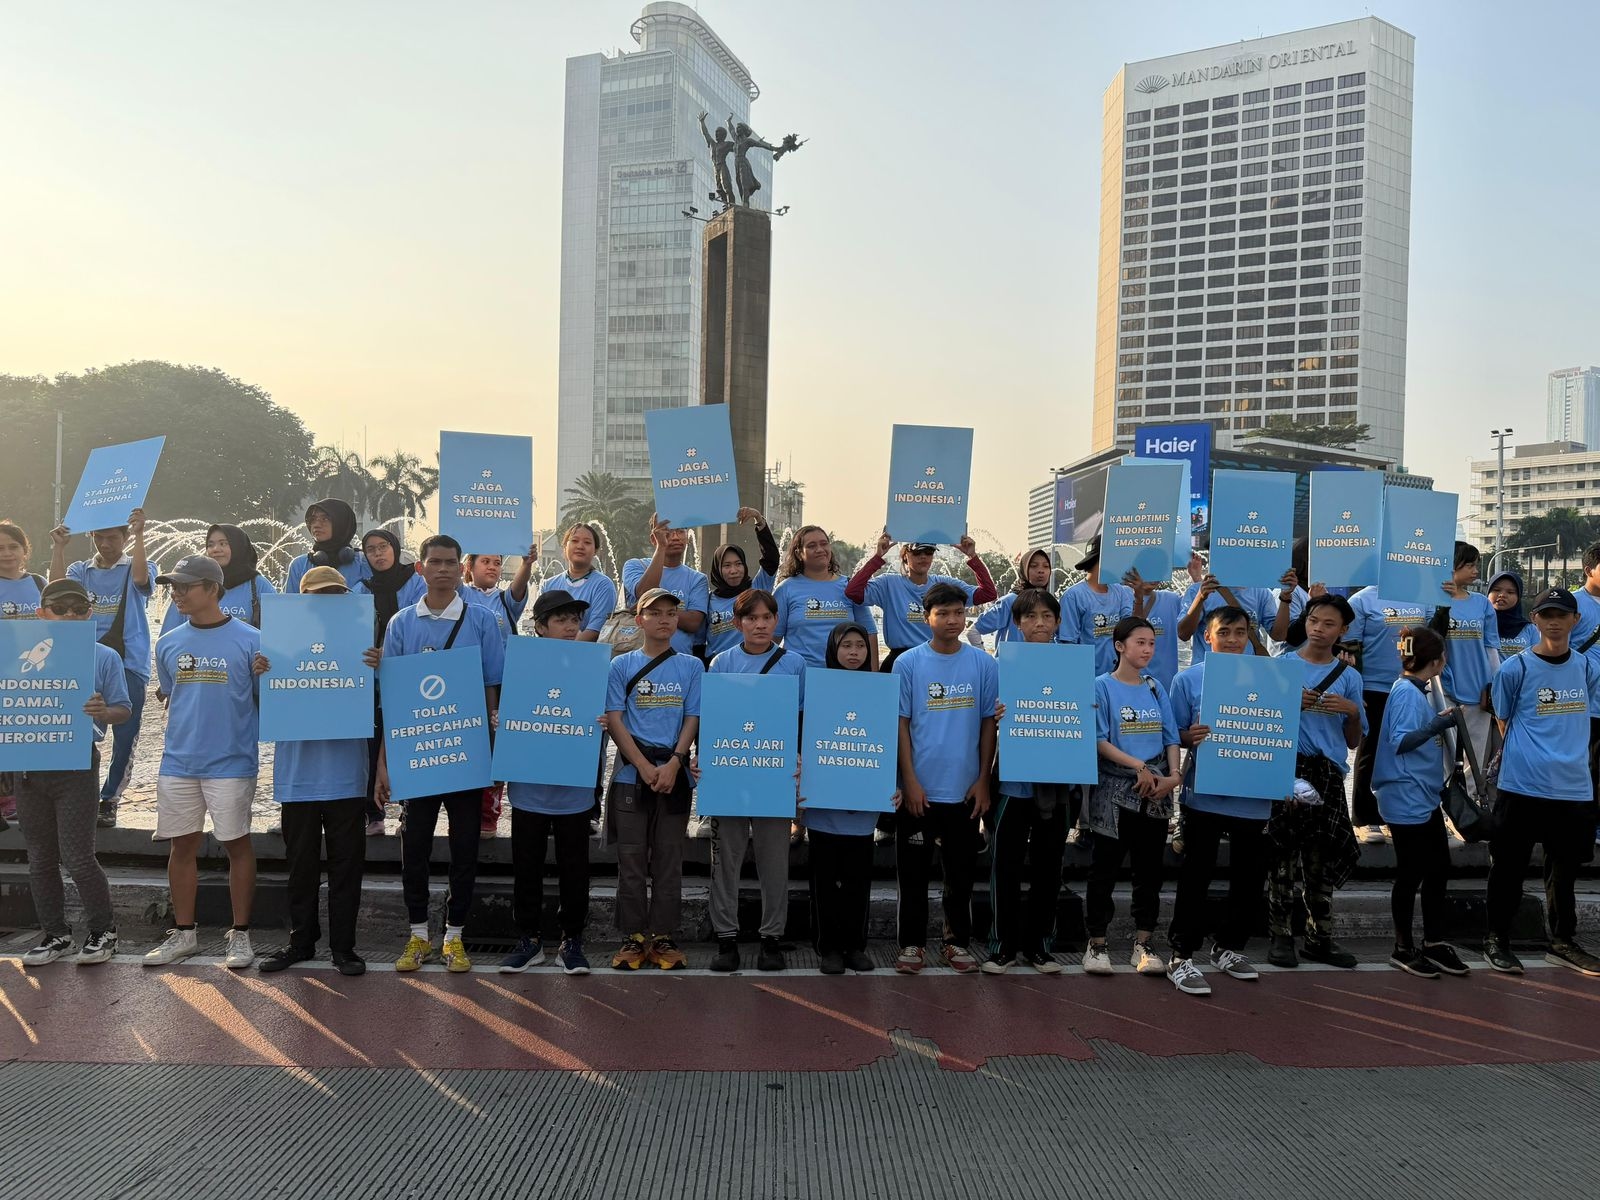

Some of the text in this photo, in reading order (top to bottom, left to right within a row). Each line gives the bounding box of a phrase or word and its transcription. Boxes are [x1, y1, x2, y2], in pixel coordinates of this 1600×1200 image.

[1172, 40, 1357, 87] MANDARIN ORIENTAL
[1145, 437, 1197, 453] Haier
[678, 461, 709, 472] JAGA
[101, 475, 129, 486] JAGA
[660, 474, 723, 489] INDONESIA
[914, 480, 944, 490] JAGA
[84, 482, 139, 498] STABILITAS
[470, 482, 503, 492] JAGA
[82, 493, 133, 507] NASIONAL
[453, 494, 520, 506] STABILITAS
[895, 493, 954, 504] INDONESIA
[456, 508, 517, 519] NASIONAL
[1109, 514, 1170, 523] KAMI OPTIMIS
[1115, 526, 1163, 535] INDONESIA
[1236, 525, 1268, 535] JAGA
[1332, 525, 1360, 534] JAGA
[1114, 537, 1162, 547] EMAS 2045
[1217, 538, 1279, 549] INDONESIA
[1315, 538, 1370, 548] INDONESIA
[1404, 541, 1432, 552] JAGA
[1386, 552, 1441, 566] INDONESIA
[296, 661, 340, 672] JAGA
[0, 679, 79, 690] NDONESIA
[269, 678, 355, 689] INDONESIA
[3, 696, 64, 709] DAMAI,
[1016, 699, 1078, 710] INDONESIA
[412, 703, 458, 720] TOLAK
[532, 704, 572, 718] JAGA
[1219, 704, 1283, 718] INDONESIA
[0, 714, 72, 725] KONOMI
[1014, 714, 1081, 725] MENUJU 0%
[391, 716, 482, 739] PERPECAHAN
[505, 719, 585, 737] INDONESIA
[833, 726, 867, 737] JAGA
[1215, 719, 1284, 733] MENUJU 8%
[0, 731, 73, 744] EROKET!
[1009, 728, 1082, 739] KEMISKINAN
[415, 736, 462, 752] ANTAR
[712, 739, 784, 751] JAGA JARI
[1204, 732, 1292, 748] PERTUMBUHAN
[815, 740, 884, 753] STABILITAS
[409, 751, 468, 770] BANGSA
[1217, 748, 1273, 761] EKONOMI
[711, 756, 784, 768] JAGA NKRI
[818, 755, 880, 769] NASIONAL
